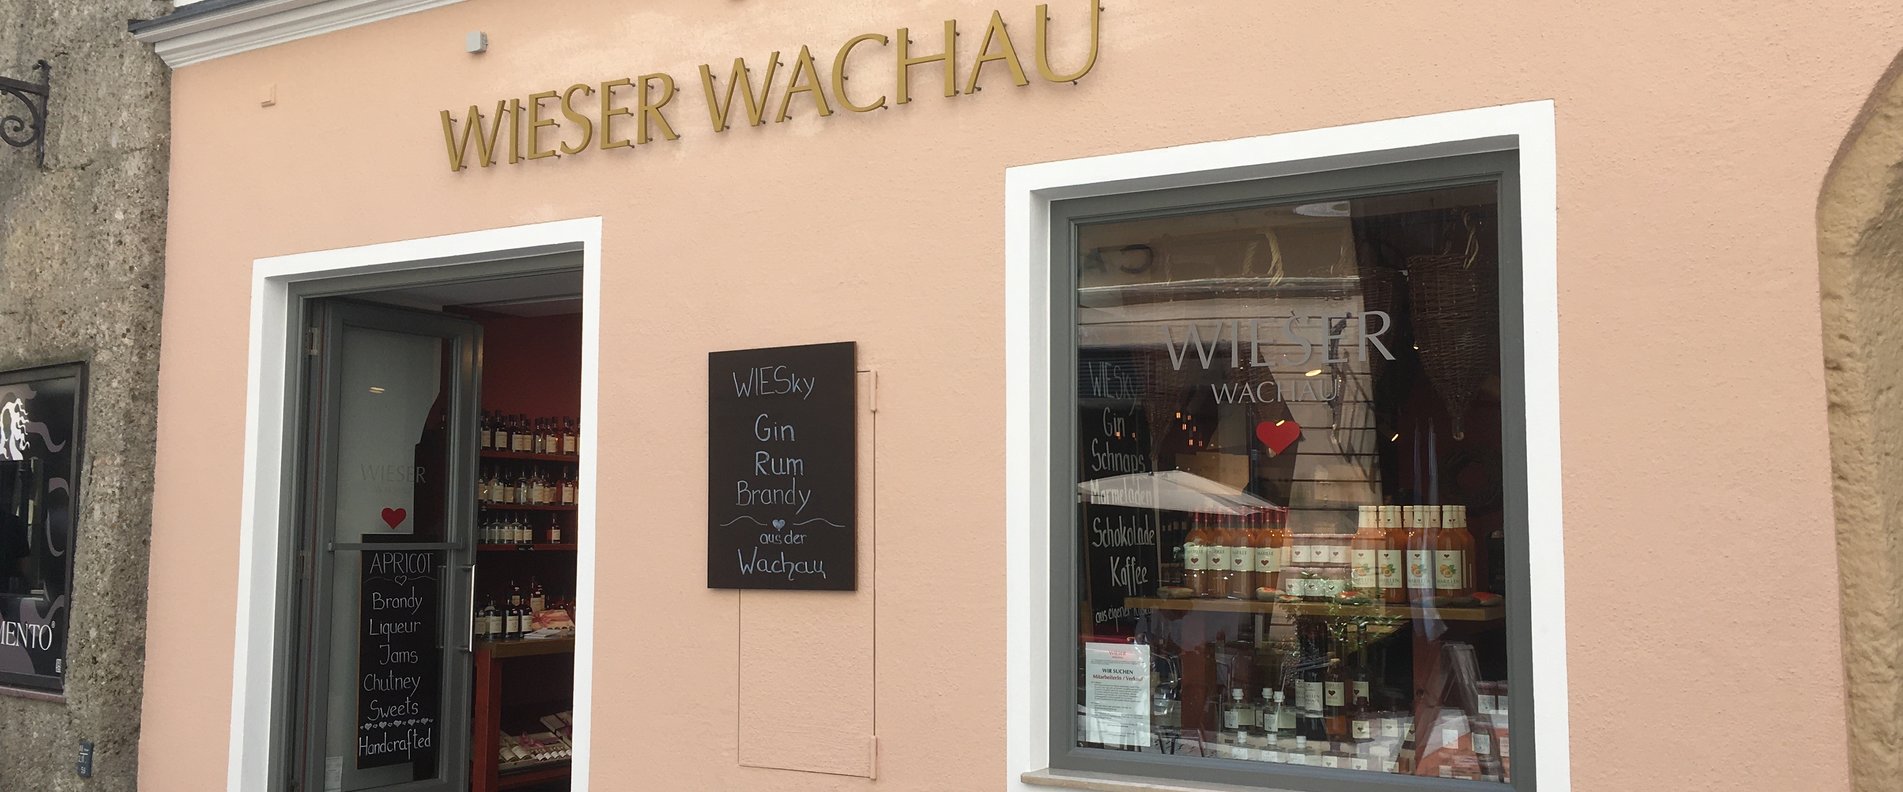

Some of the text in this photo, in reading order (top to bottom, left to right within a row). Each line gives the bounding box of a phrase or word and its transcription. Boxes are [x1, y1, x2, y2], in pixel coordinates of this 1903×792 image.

[440, 0, 1103, 171] WIESER WACHAU
[1161, 310, 1396, 371] WIESER
[732, 365, 816, 400] WIESky
[1210, 378, 1340, 404] WACHAU
[754, 413, 796, 442] Gin
[1103, 406, 1126, 438] Gin
[360, 463, 427, 484] WIESER
[754, 450, 805, 477] Rum
[1091, 438, 1147, 484] Schnaps
[735, 477, 812, 515] Brandy
[1090, 478, 1153, 506] Marmeladen
[759, 530, 808, 545] aus der
[1091, 514, 1155, 548] Schokolade
[369, 552, 434, 574] APRICOT
[737, 546, 827, 581] Wachau
[1110, 556, 1149, 596] Kaffee
[372, 586, 423, 615] Brandy
[369, 618, 421, 642] Liqueur
[379, 643, 419, 665] Jams
[363, 669, 421, 698] Chutney
[367, 696, 419, 721] Sweets
[358, 727, 432, 760] Handcrafted
